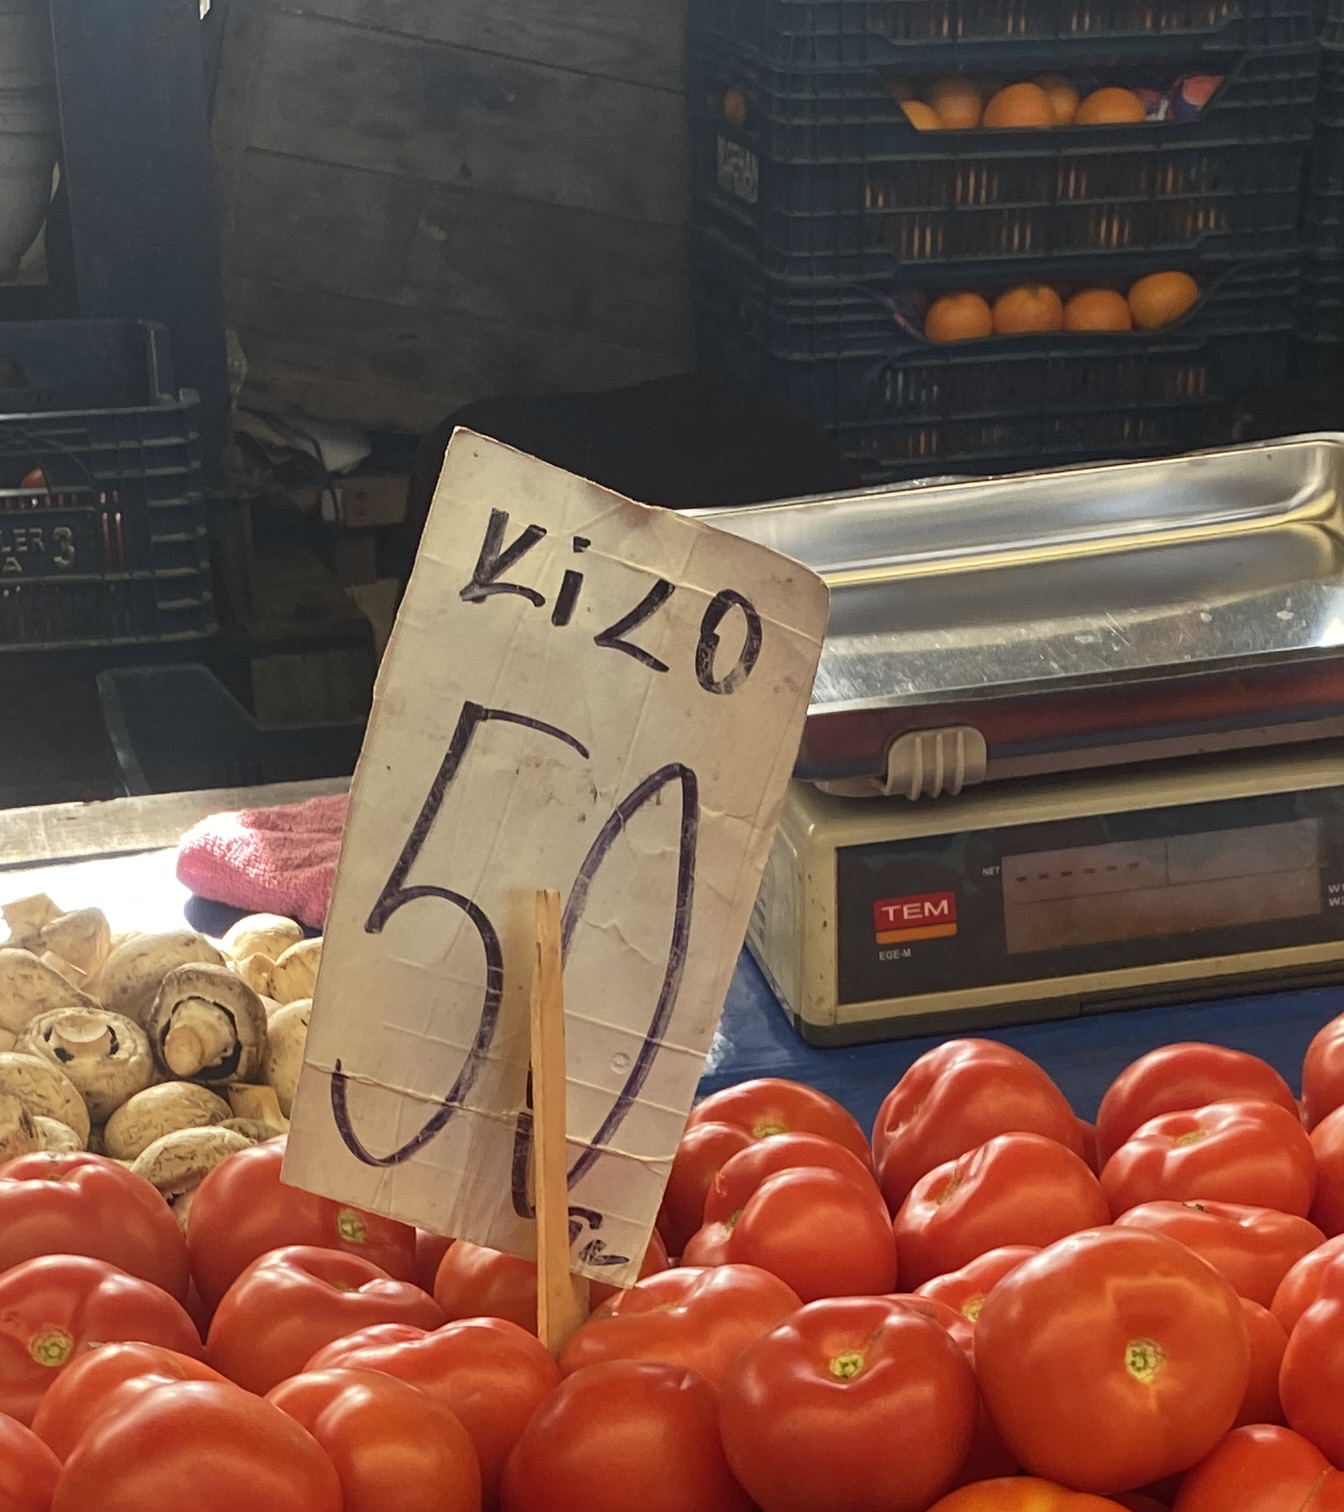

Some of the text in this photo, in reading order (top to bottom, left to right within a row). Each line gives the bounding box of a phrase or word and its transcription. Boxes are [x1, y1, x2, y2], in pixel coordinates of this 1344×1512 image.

[982, 866, 1001, 876] NET
[880, 899, 949, 922] TEM
[331, 701, 698, 1220] 50
[879, 948, 912, 961] EGE-M
